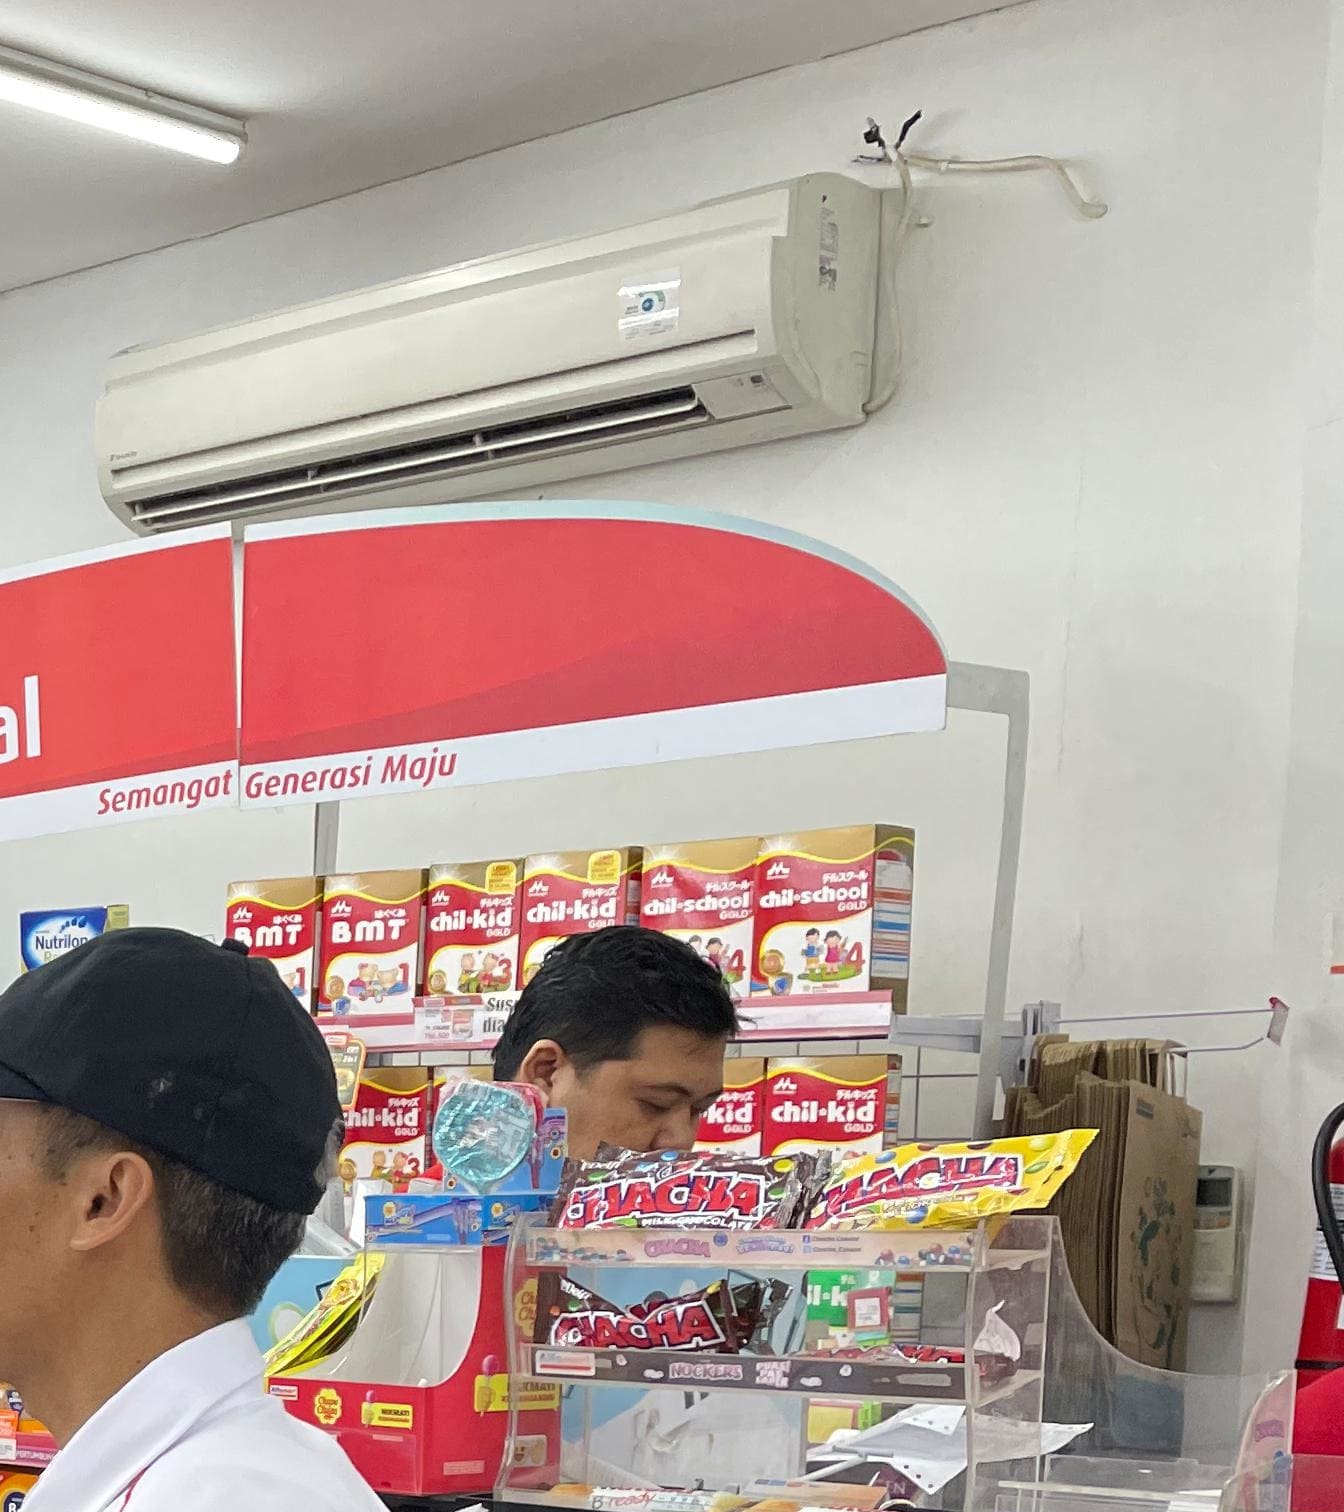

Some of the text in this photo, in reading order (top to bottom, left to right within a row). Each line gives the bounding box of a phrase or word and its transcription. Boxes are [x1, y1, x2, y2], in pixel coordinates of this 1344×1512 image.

[97, 748, 458, 816] Semangat Generasi Maju
[837, 901, 867, 912] GOLD
[719, 909, 749, 920] GOLD
[332, 918, 407, 944] BMT
[394, 1127, 419, 1137] GOLD
[723, 1122, 752, 1133] GOLD
[843, 1121, 873, 1133] GOLD
